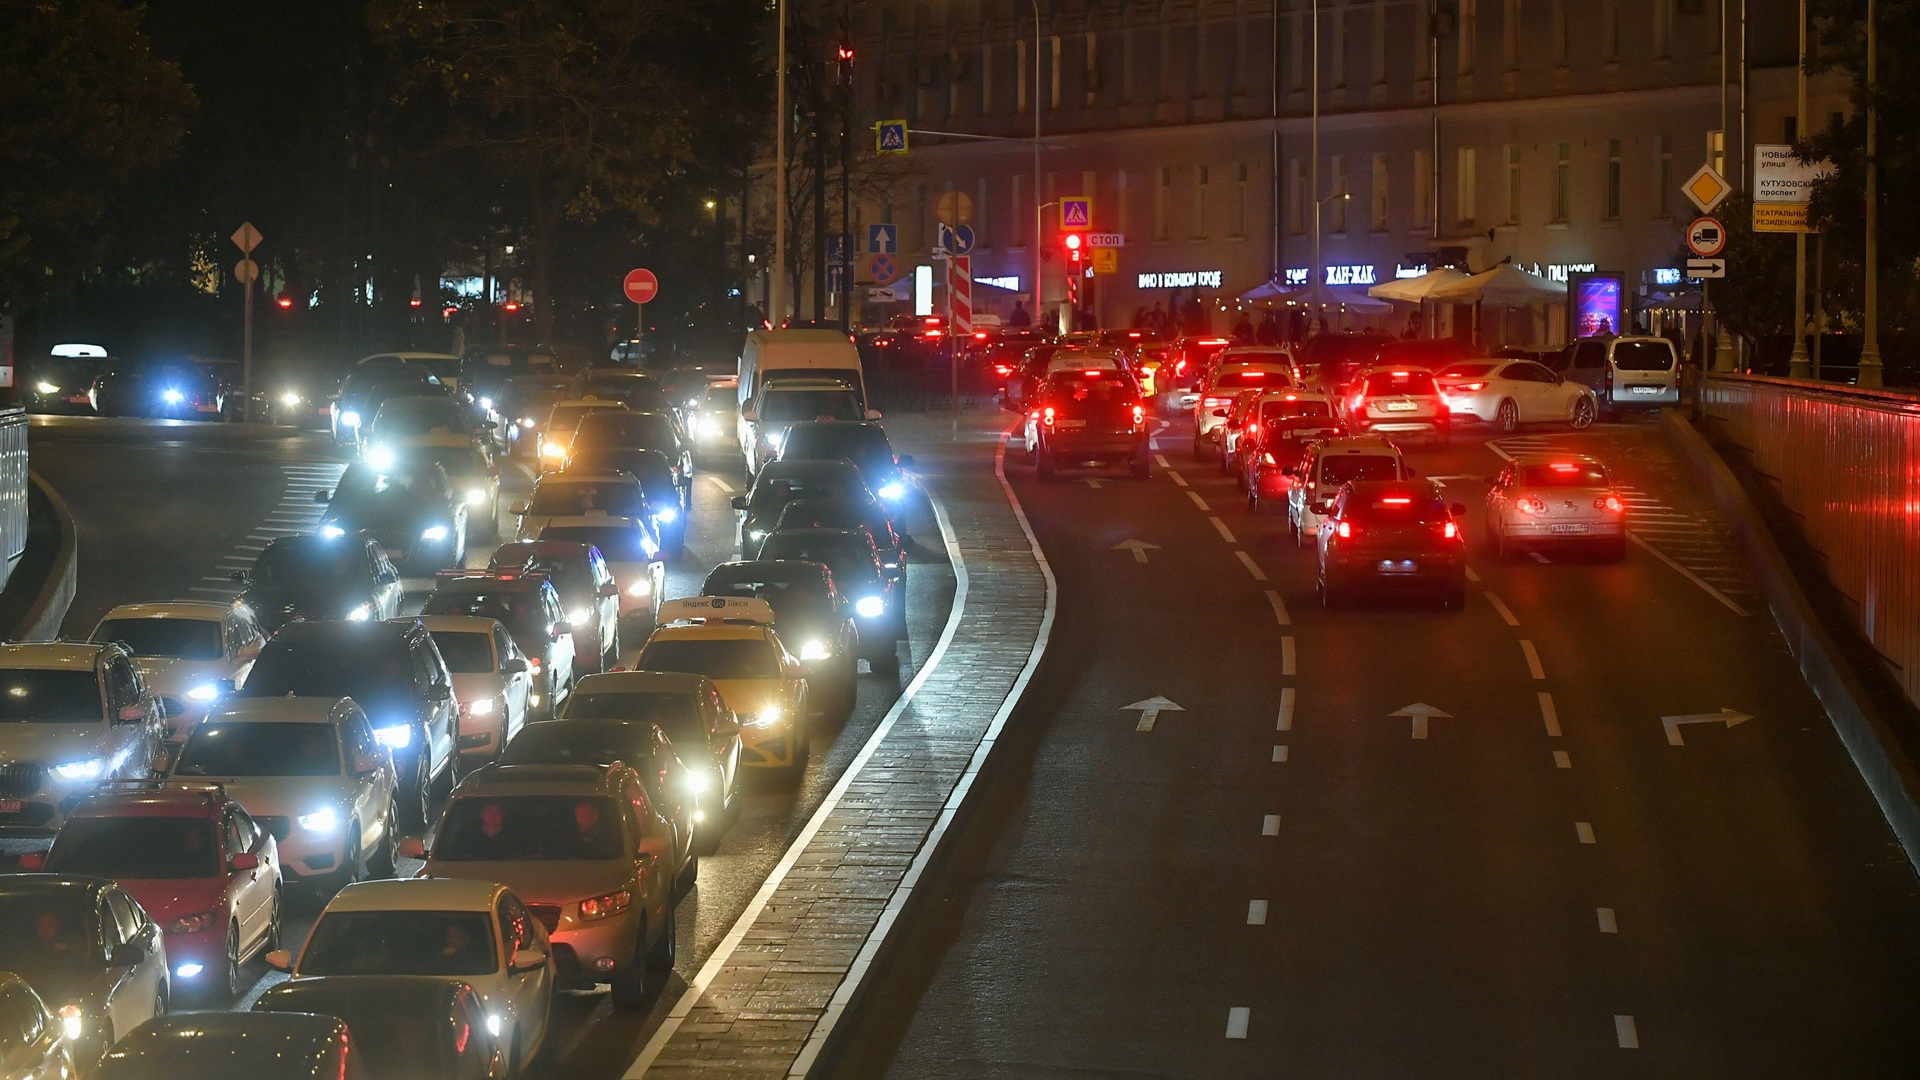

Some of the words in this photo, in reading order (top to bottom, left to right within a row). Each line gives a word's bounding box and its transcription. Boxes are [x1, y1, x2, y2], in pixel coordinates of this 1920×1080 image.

[1091, 235, 1119, 245] СТОП
[1138, 273, 1157, 288] ВИНО
[1158, 273, 1163, 288] В
[1164, 271, 1197, 288] БОЛЬШОМ
[1198, 270, 1222, 288] ГОРОДЕ
[1325, 264, 1376, 284] ЖАН-ЖАК
[682, 600, 710, 608] Яндекс
[712, 599, 724, 607] Go
